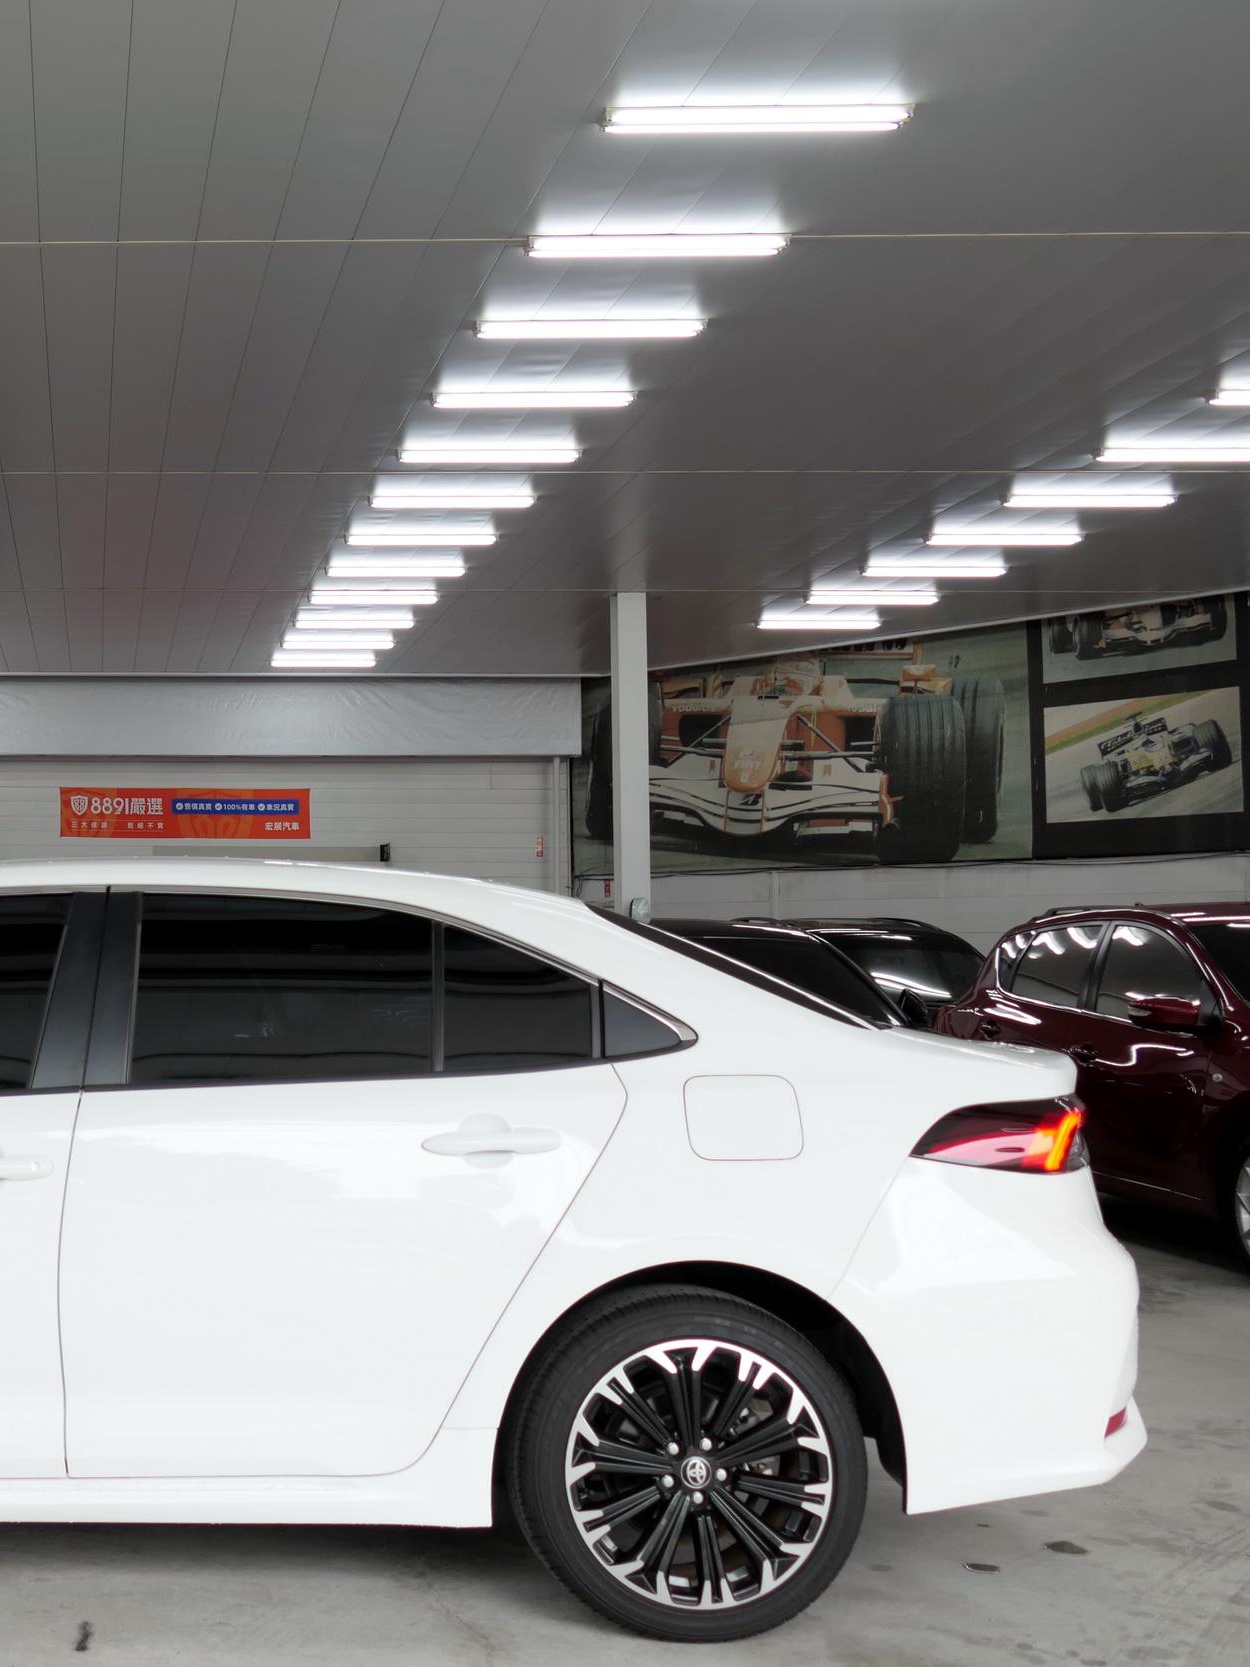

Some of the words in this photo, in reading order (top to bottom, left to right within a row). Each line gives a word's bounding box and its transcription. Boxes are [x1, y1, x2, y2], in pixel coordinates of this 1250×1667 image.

[90, 797, 163, 815] 8891嚴選
[264, 822, 300, 831] 宏展汽車
